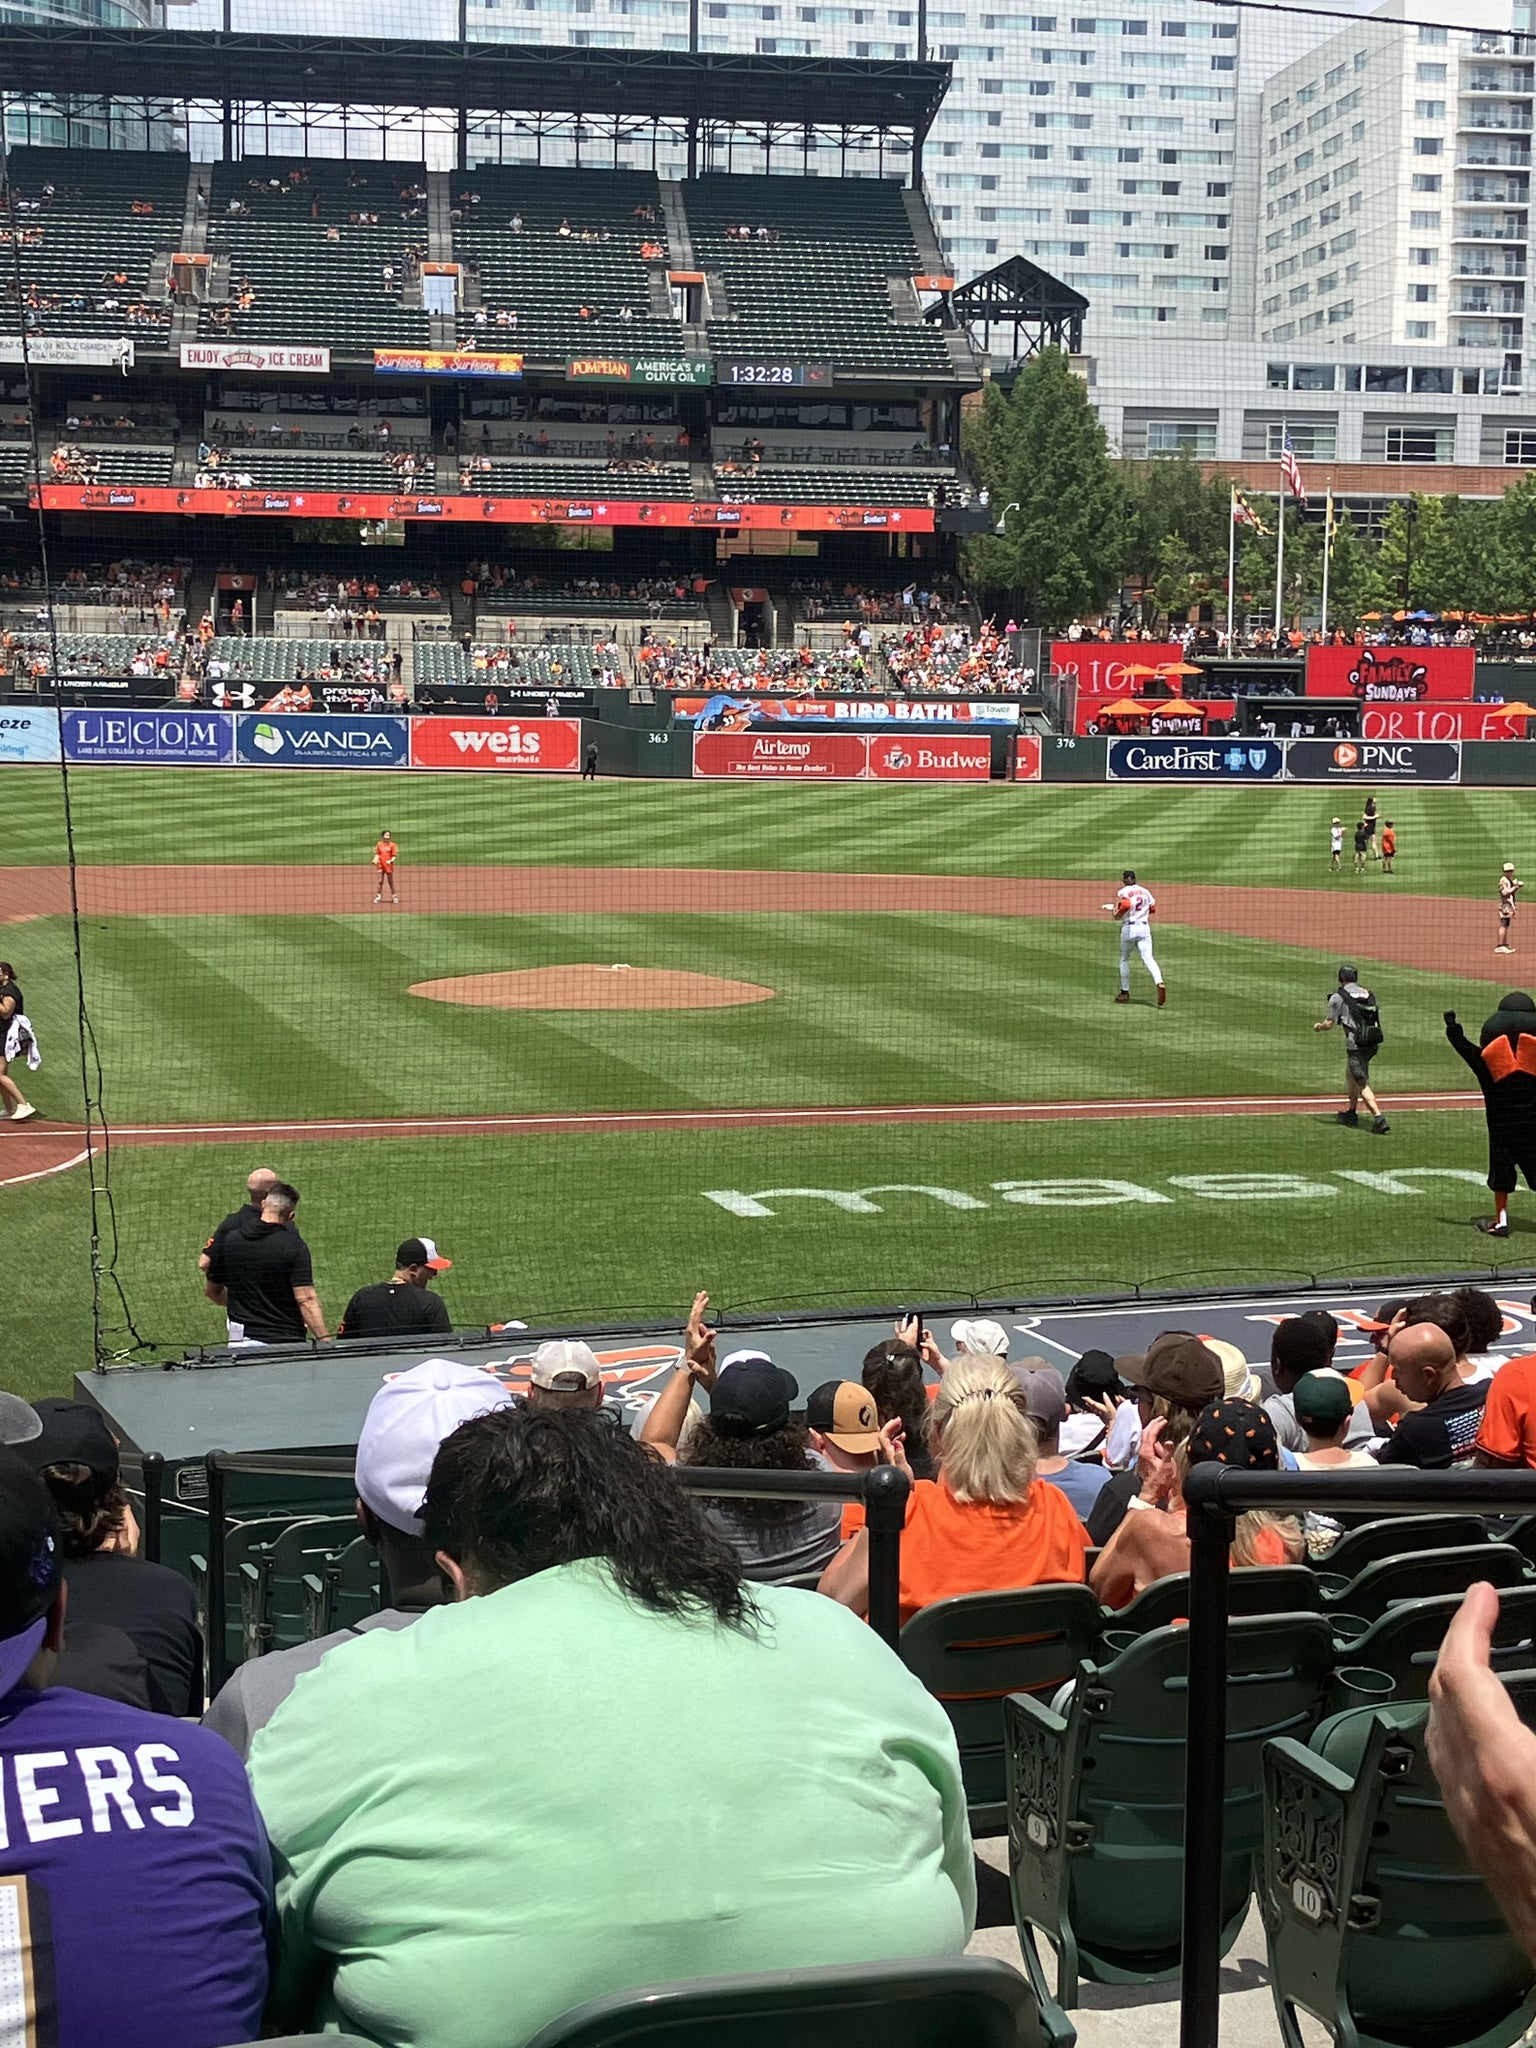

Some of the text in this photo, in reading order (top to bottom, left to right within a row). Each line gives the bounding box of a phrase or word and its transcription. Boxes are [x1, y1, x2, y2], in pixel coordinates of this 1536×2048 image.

[187, 349, 219, 363] ENJOY
[269, 352, 284, 365] ICE
[290, 353, 323, 366] CREAM
[376, 354, 422, 368] Surfside
[450, 357, 496, 371] Surfside
[573, 361, 628, 375] POMPEIAN
[635, 361, 691, 372] AMERICA'S
[731, 366, 793, 383] 1:32:28
[645, 372, 696, 382] OLIVE OIL
[522, 690, 550, 698] UNDER
[1365, 683, 1417, 701] SUNDAYS
[835, 703, 952, 720] BIRD BATH
[77, 716, 218, 748] LECOM
[286, 730, 393, 750] VANDA
[449, 724, 541, 753] weis
[648, 733, 669, 744] 363
[752, 738, 811, 758] Airtemp
[1056, 738, 1076, 749] 376
[496, 755, 540, 764] markets
[917, 750, 1027, 769] Budweir
[1126, 747, 1221, 771] CareFirst
[1361, 746, 1413, 766] PNC
[1135, 896, 1143, 911] 2
[0, 1743, 195, 1850] ERS
[1034, 1820, 1041, 1839] 9
[1301, 1886, 1316, 1912] 10
